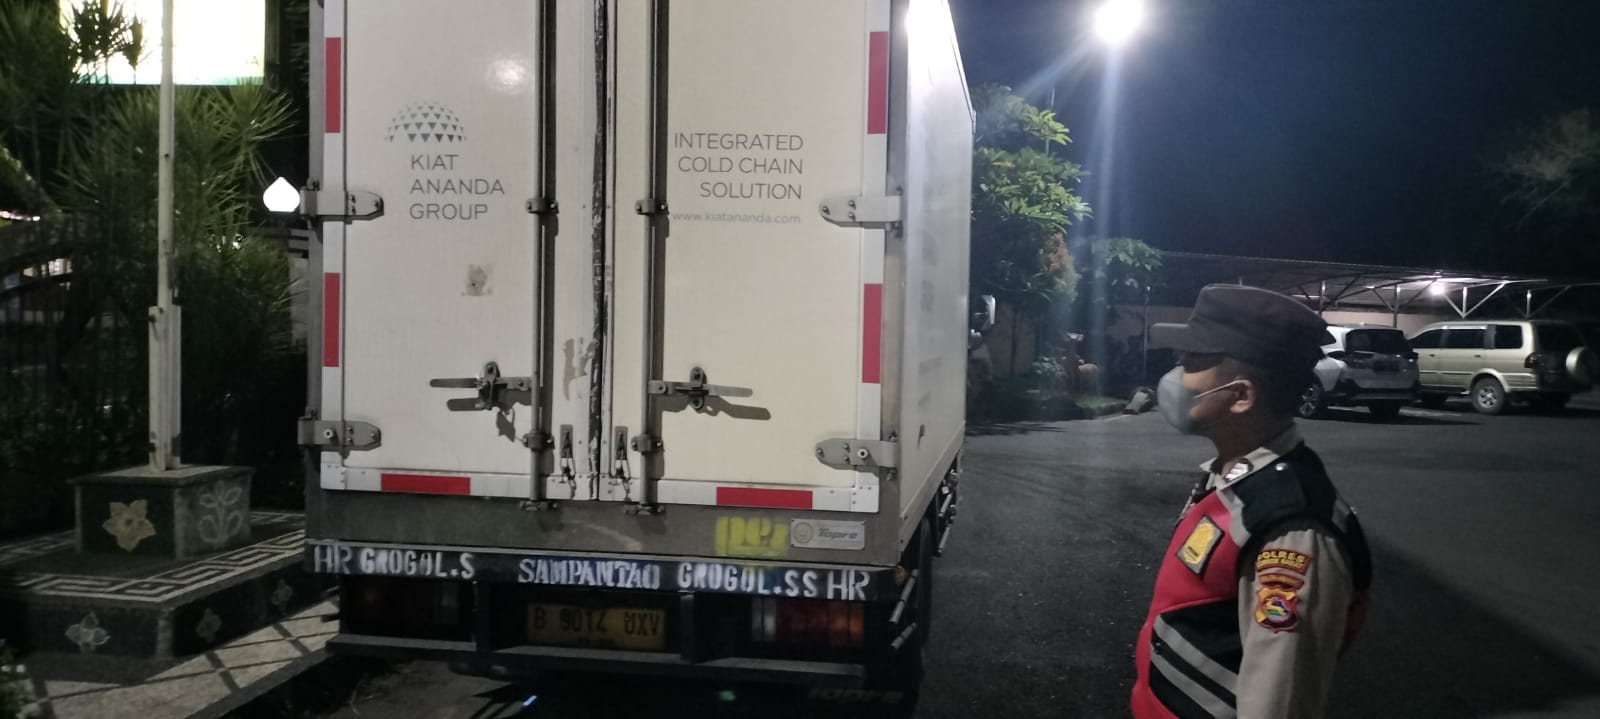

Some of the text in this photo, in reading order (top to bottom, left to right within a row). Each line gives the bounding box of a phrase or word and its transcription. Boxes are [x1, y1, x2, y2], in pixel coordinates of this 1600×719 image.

[674, 132, 804, 151] INTEGRATED
[410, 153, 460, 171] KIAT
[678, 155, 803, 175] COLD CHAIN
[409, 178, 505, 195] ANANDA
[700, 181, 802, 200] SOLUTION
[409, 202, 489, 220] GROUP
[672, 210, 802, 224] www.kiatananda.com
[818, 527, 858, 540] Topre
[313, 544, 352, 575] HR
[827, 568, 871, 601] HR
[534, 607, 546, 629] B
